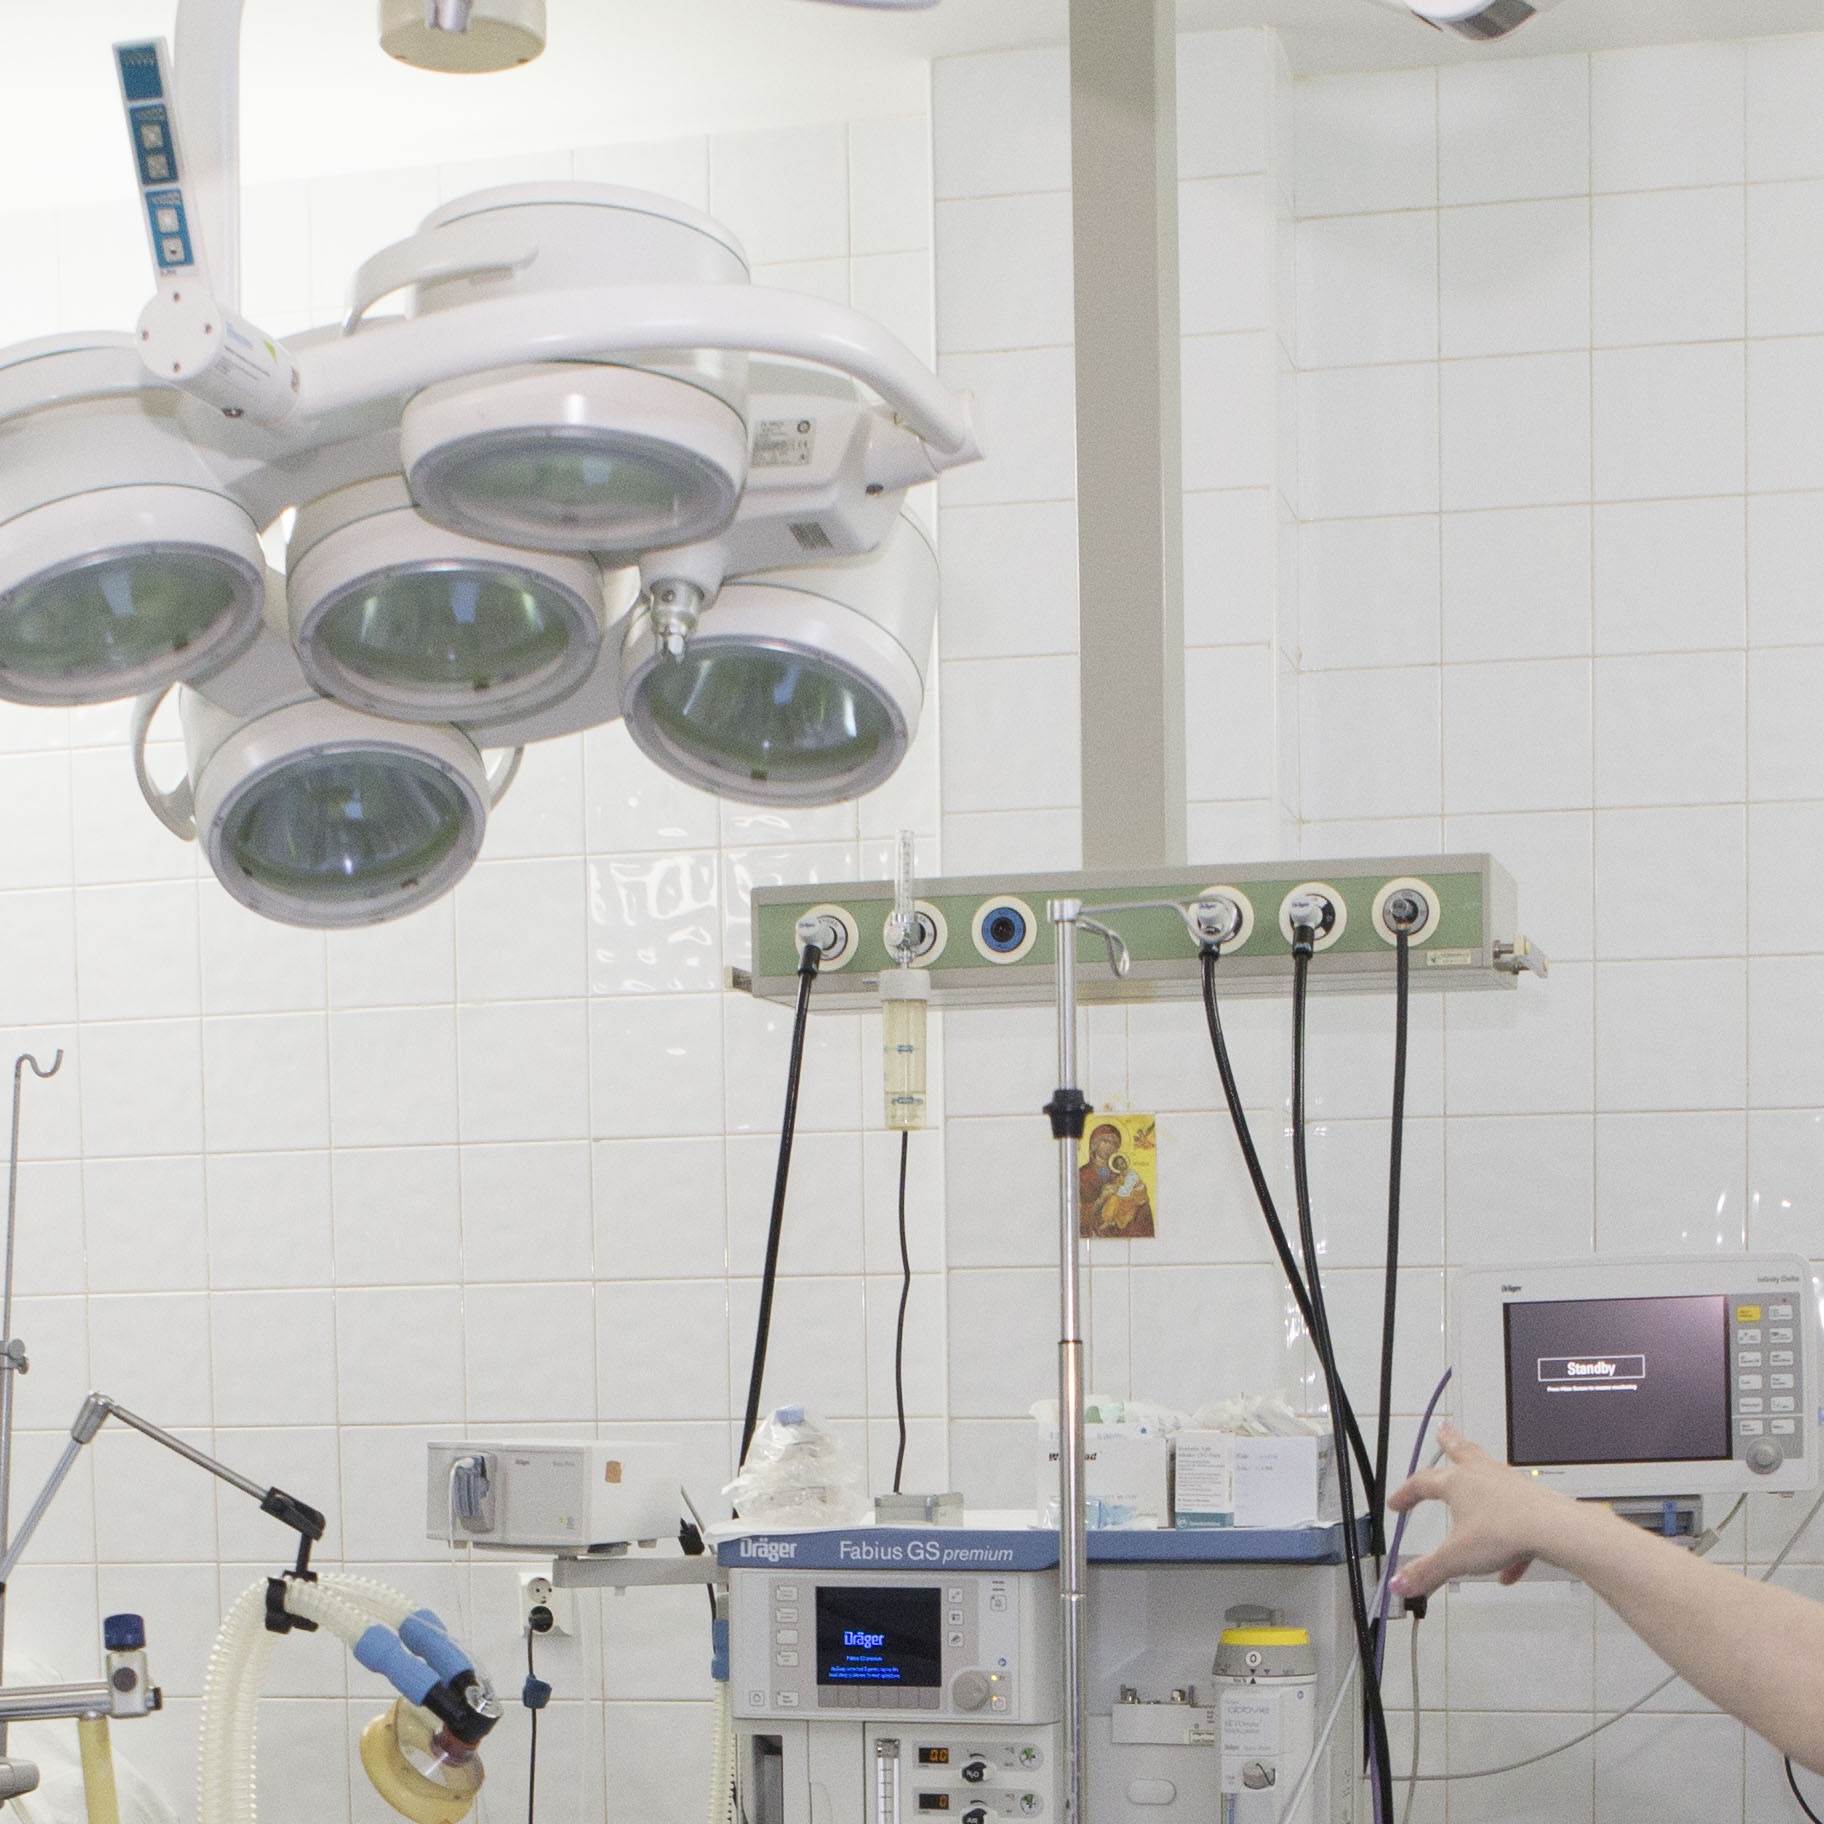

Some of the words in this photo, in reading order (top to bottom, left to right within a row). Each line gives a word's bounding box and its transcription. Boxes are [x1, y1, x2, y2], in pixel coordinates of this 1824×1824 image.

[1567, 1361, 1616, 1377] Standby
[740, 1537, 797, 1562] Dräger
[839, 1540, 903, 1561] Fabius
[907, 1540, 940, 1561] GS
[942, 1545, 1014, 1564] premium
[844, 1631, 885, 1649] Dräger
